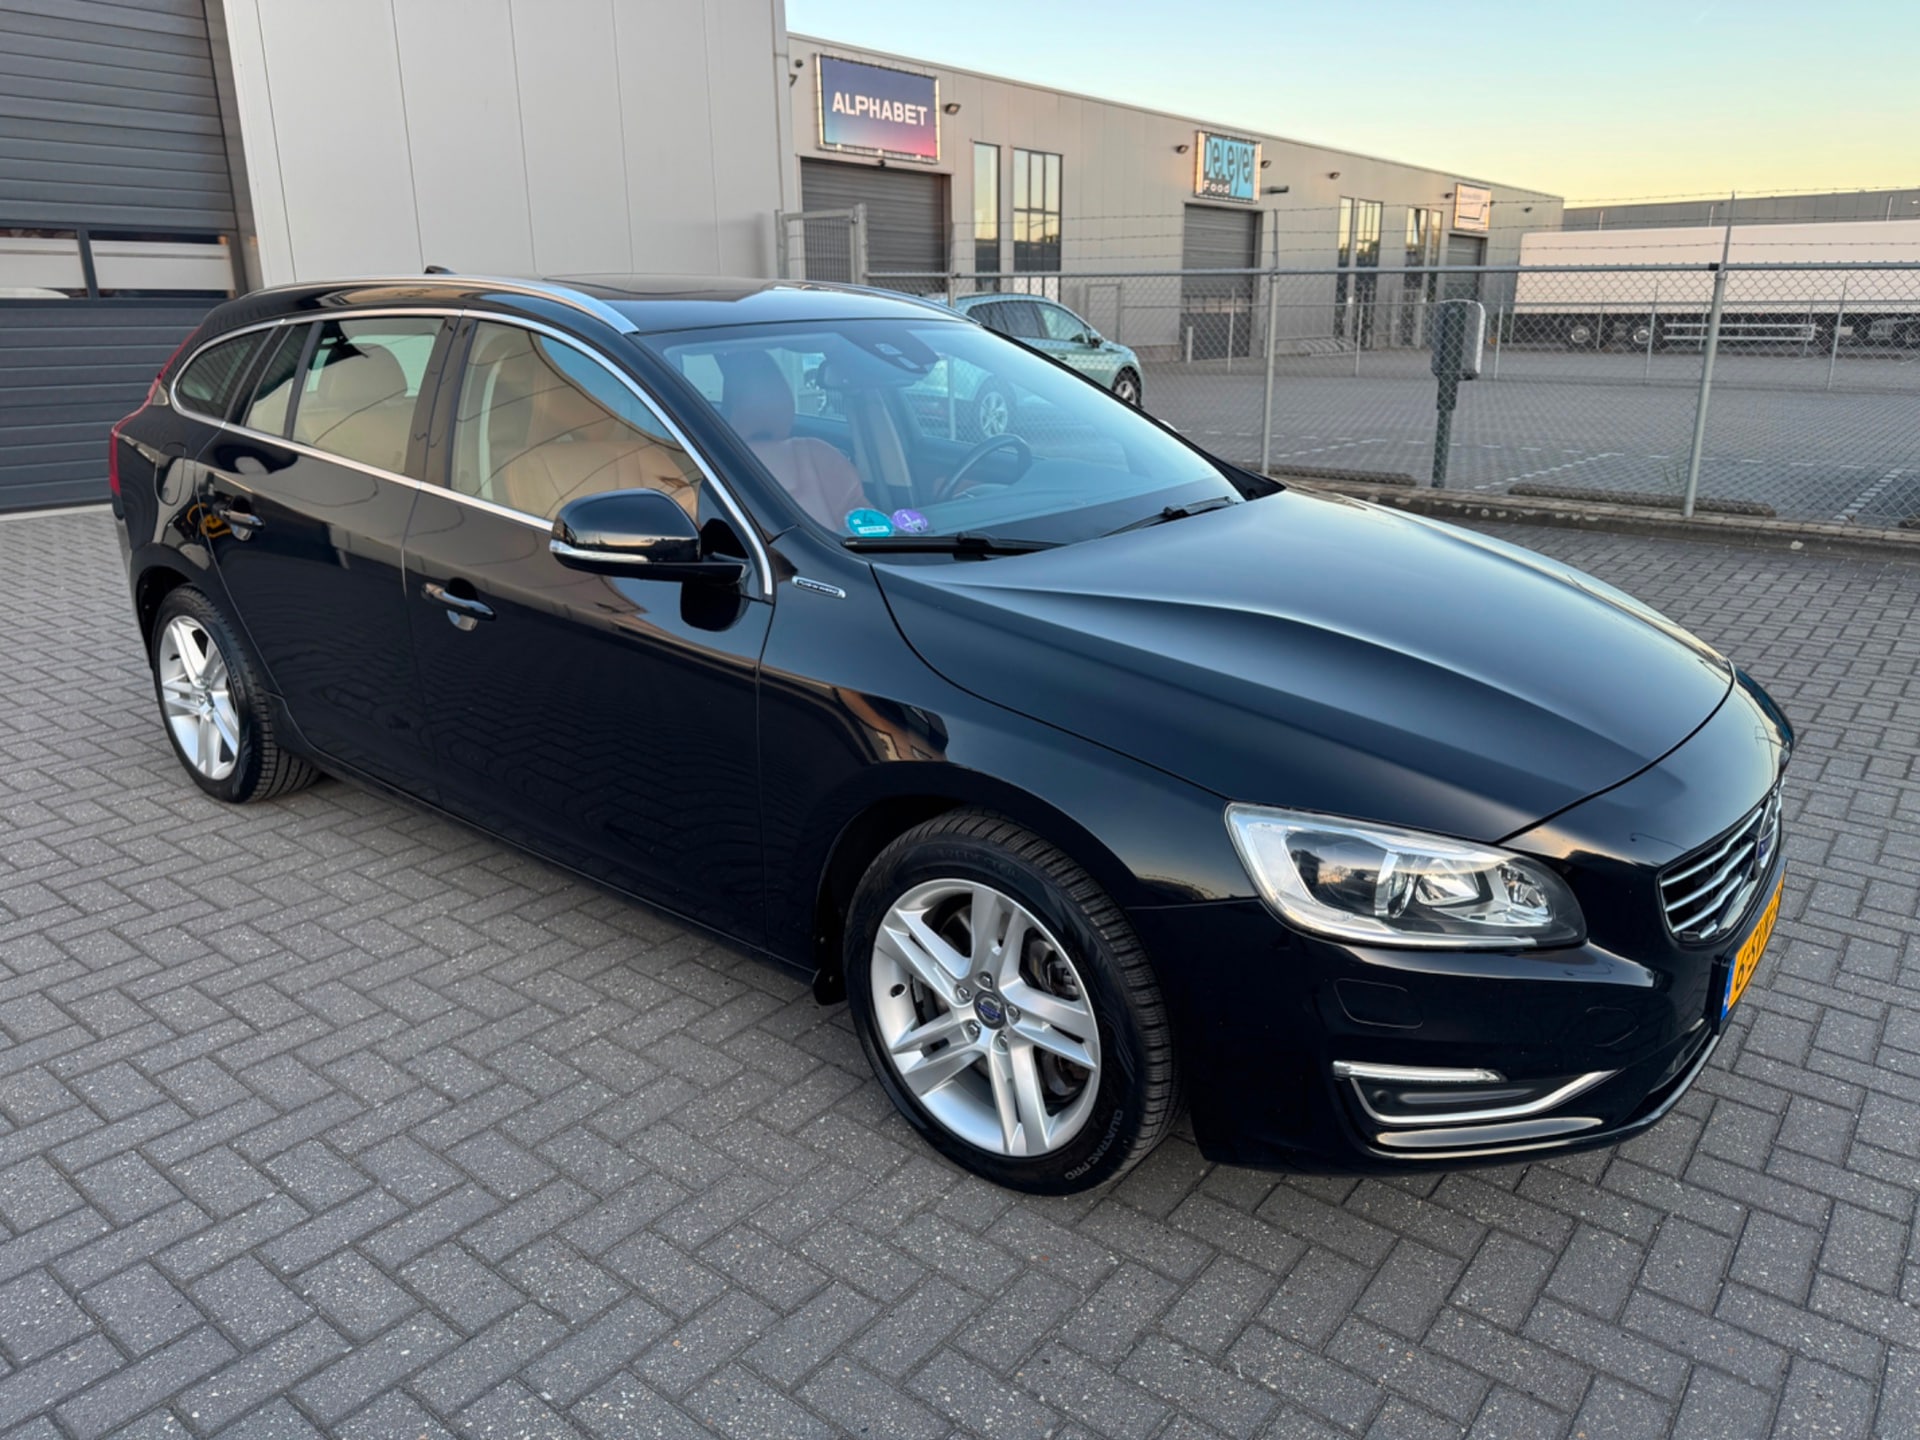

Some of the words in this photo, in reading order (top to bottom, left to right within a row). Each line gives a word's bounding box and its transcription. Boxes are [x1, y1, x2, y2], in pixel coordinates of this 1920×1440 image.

[832, 91, 928, 126] ALPHABET
[1203, 180, 1230, 193] Food
[1088, 1109, 1123, 1165] QUATRAC
[1064, 1162, 1091, 1180] PRO
